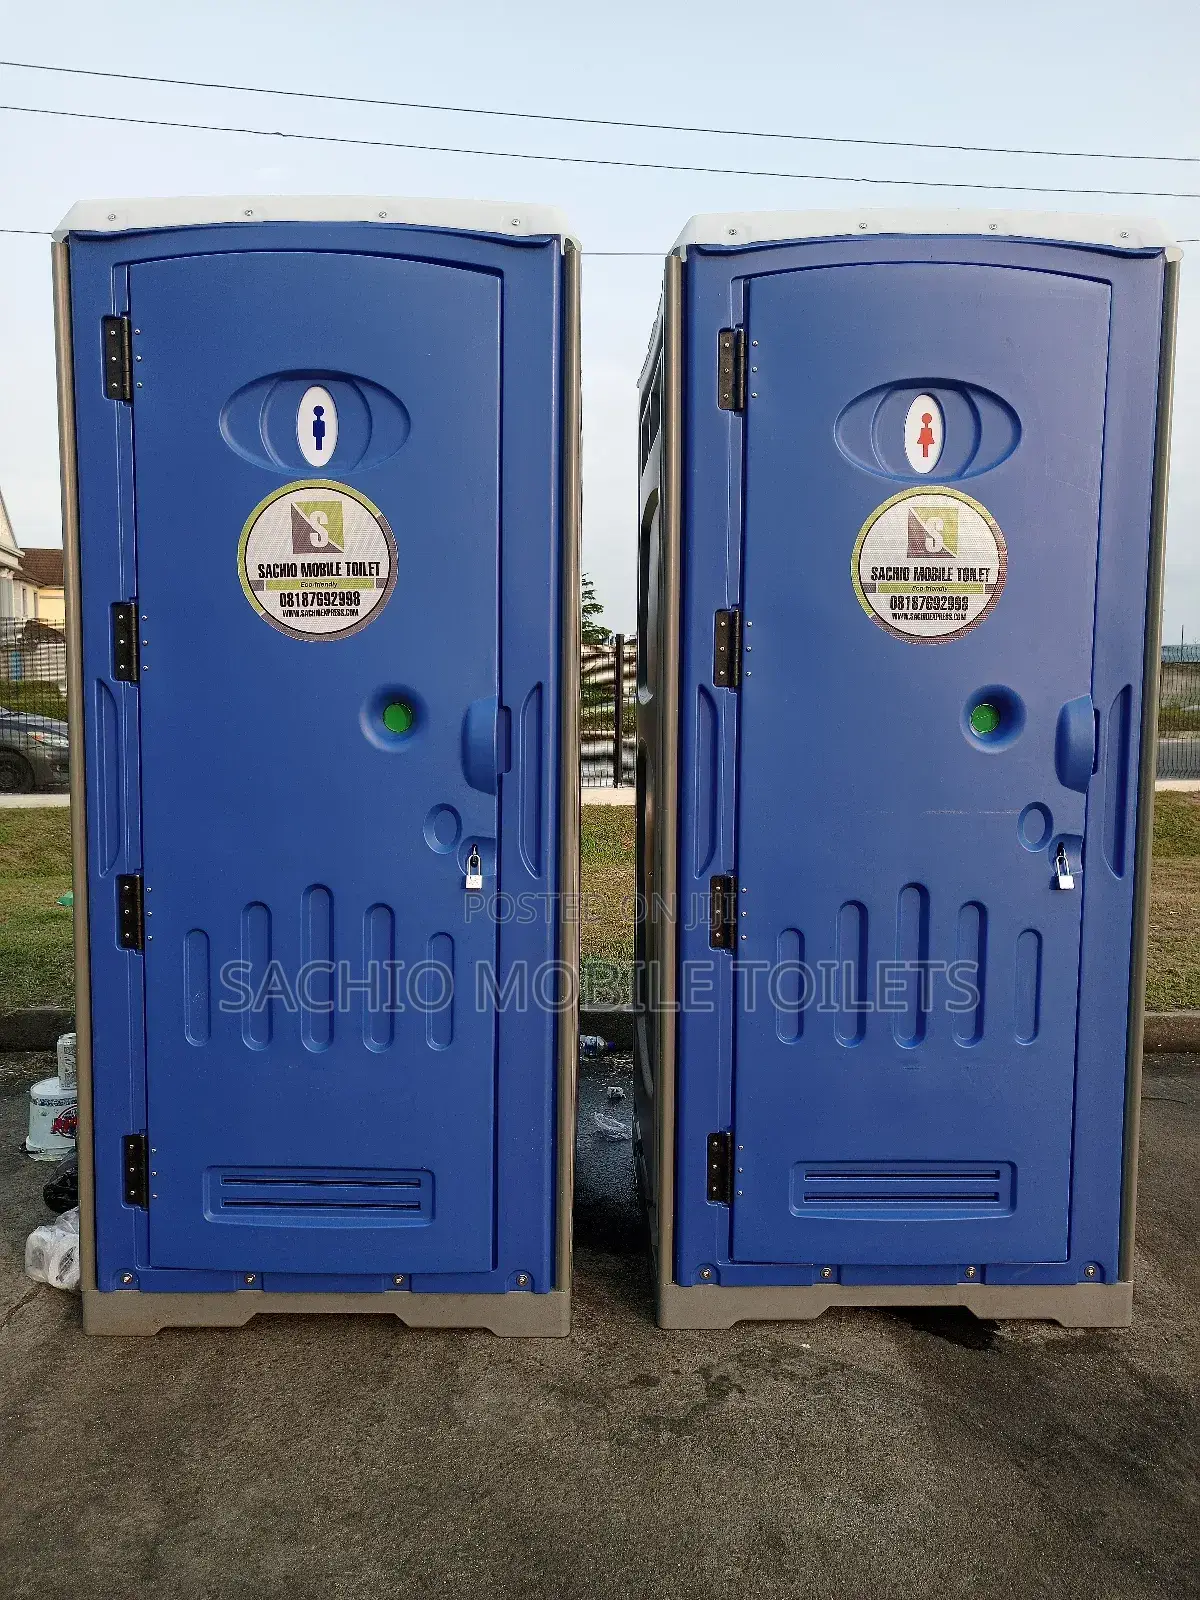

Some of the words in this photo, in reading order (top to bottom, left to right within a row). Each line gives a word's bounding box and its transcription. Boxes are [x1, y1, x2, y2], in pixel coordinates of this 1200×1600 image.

[257, 563, 298, 579] SACHIO
[301, 562, 342, 578] MOBILE
[345, 561, 381, 577] TOILET
[870, 566, 910, 582] SACHIO
[913, 566, 953, 582] MOBILE
[957, 567, 991, 583] TOILET
[279, 591, 361, 608] 08187692998
[889, 595, 969, 611] 08187692998
